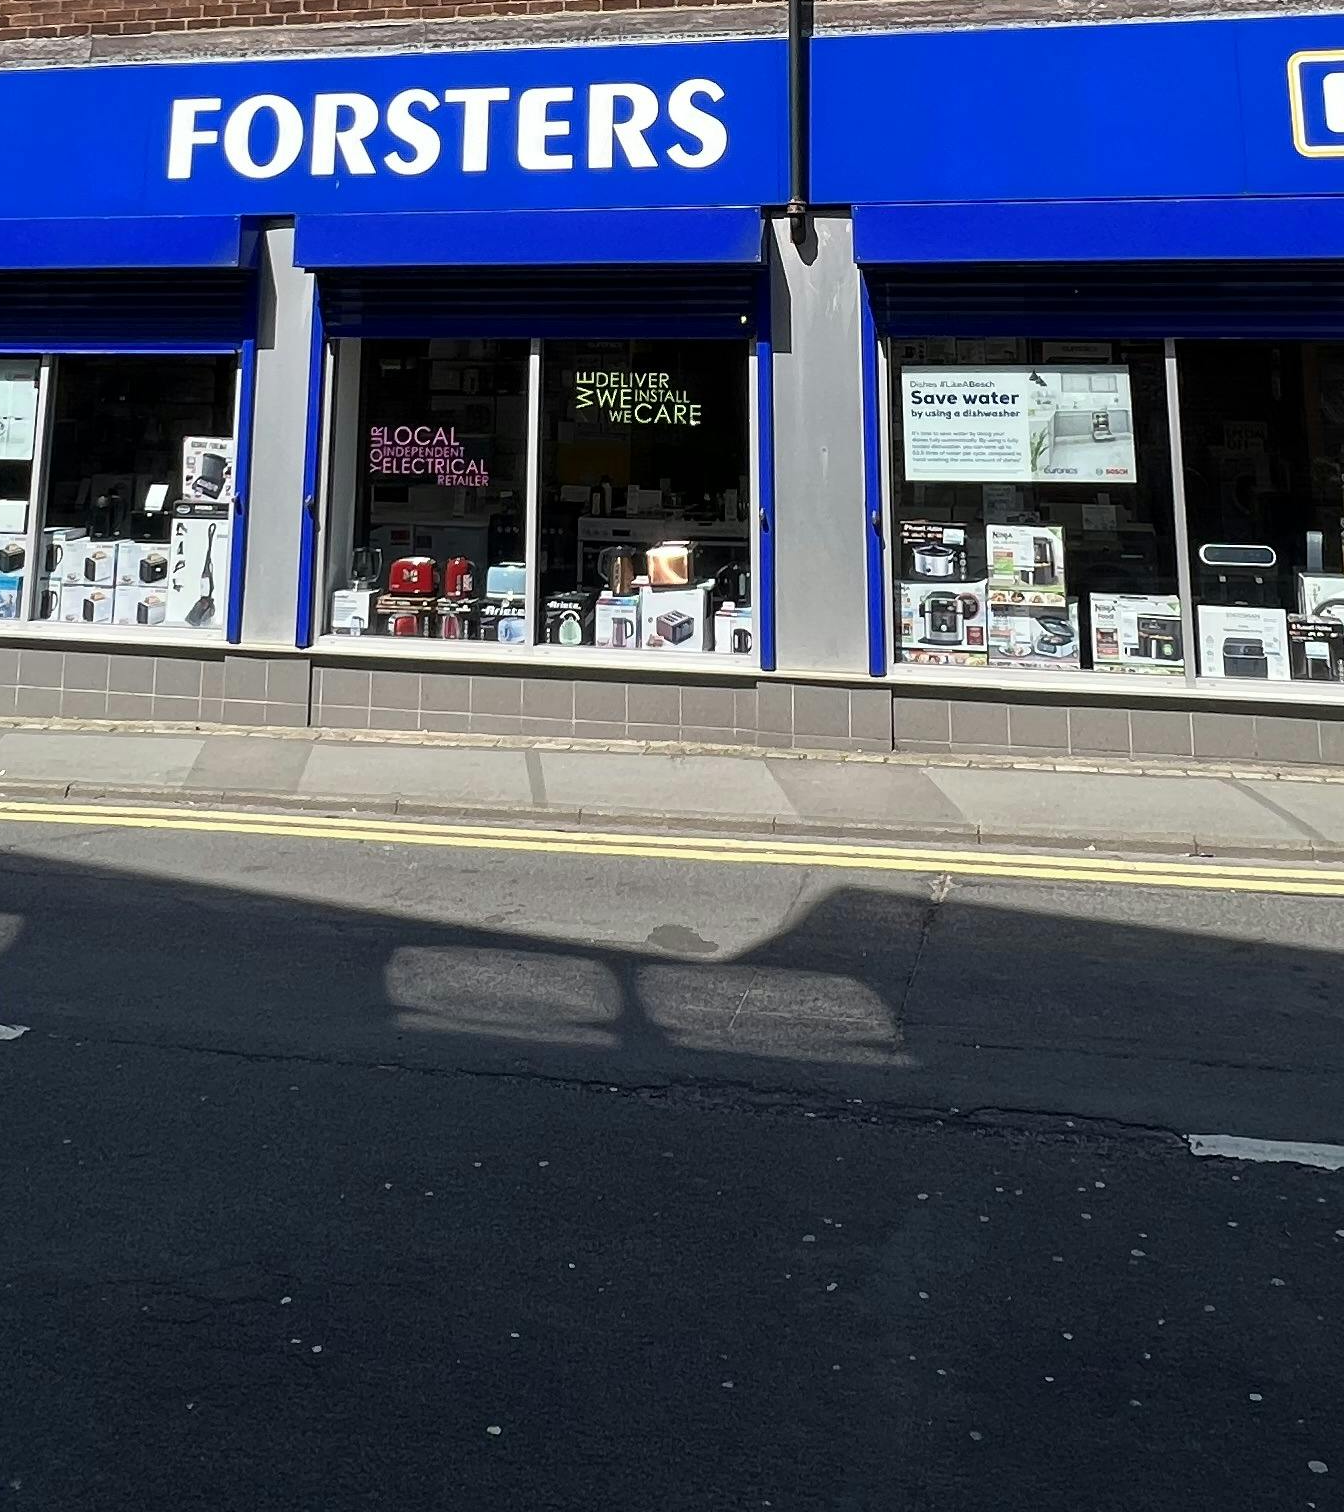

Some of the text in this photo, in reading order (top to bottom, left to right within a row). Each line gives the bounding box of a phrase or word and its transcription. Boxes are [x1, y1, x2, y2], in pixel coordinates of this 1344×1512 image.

[167, 78, 729, 180] FORSTERS
[576, 371, 595, 409] WE
[596, 372, 670, 389] DELIVER
[596, 388, 691, 409] WE INSTALL
[911, 390, 1020, 405] Save water
[609, 403, 702, 426] WE CARE
[911, 409, 923, 419] by
[925, 409, 952, 419] using
[962, 409, 1020, 417] dishwasher
[383, 426, 460, 446] LOCAL
[369, 426, 383, 473] YOUR
[383, 446, 464, 458] INDEPENDENT
[382, 457, 489, 475] ELECTRICAL
[437, 474, 489, 487] RETAILER
